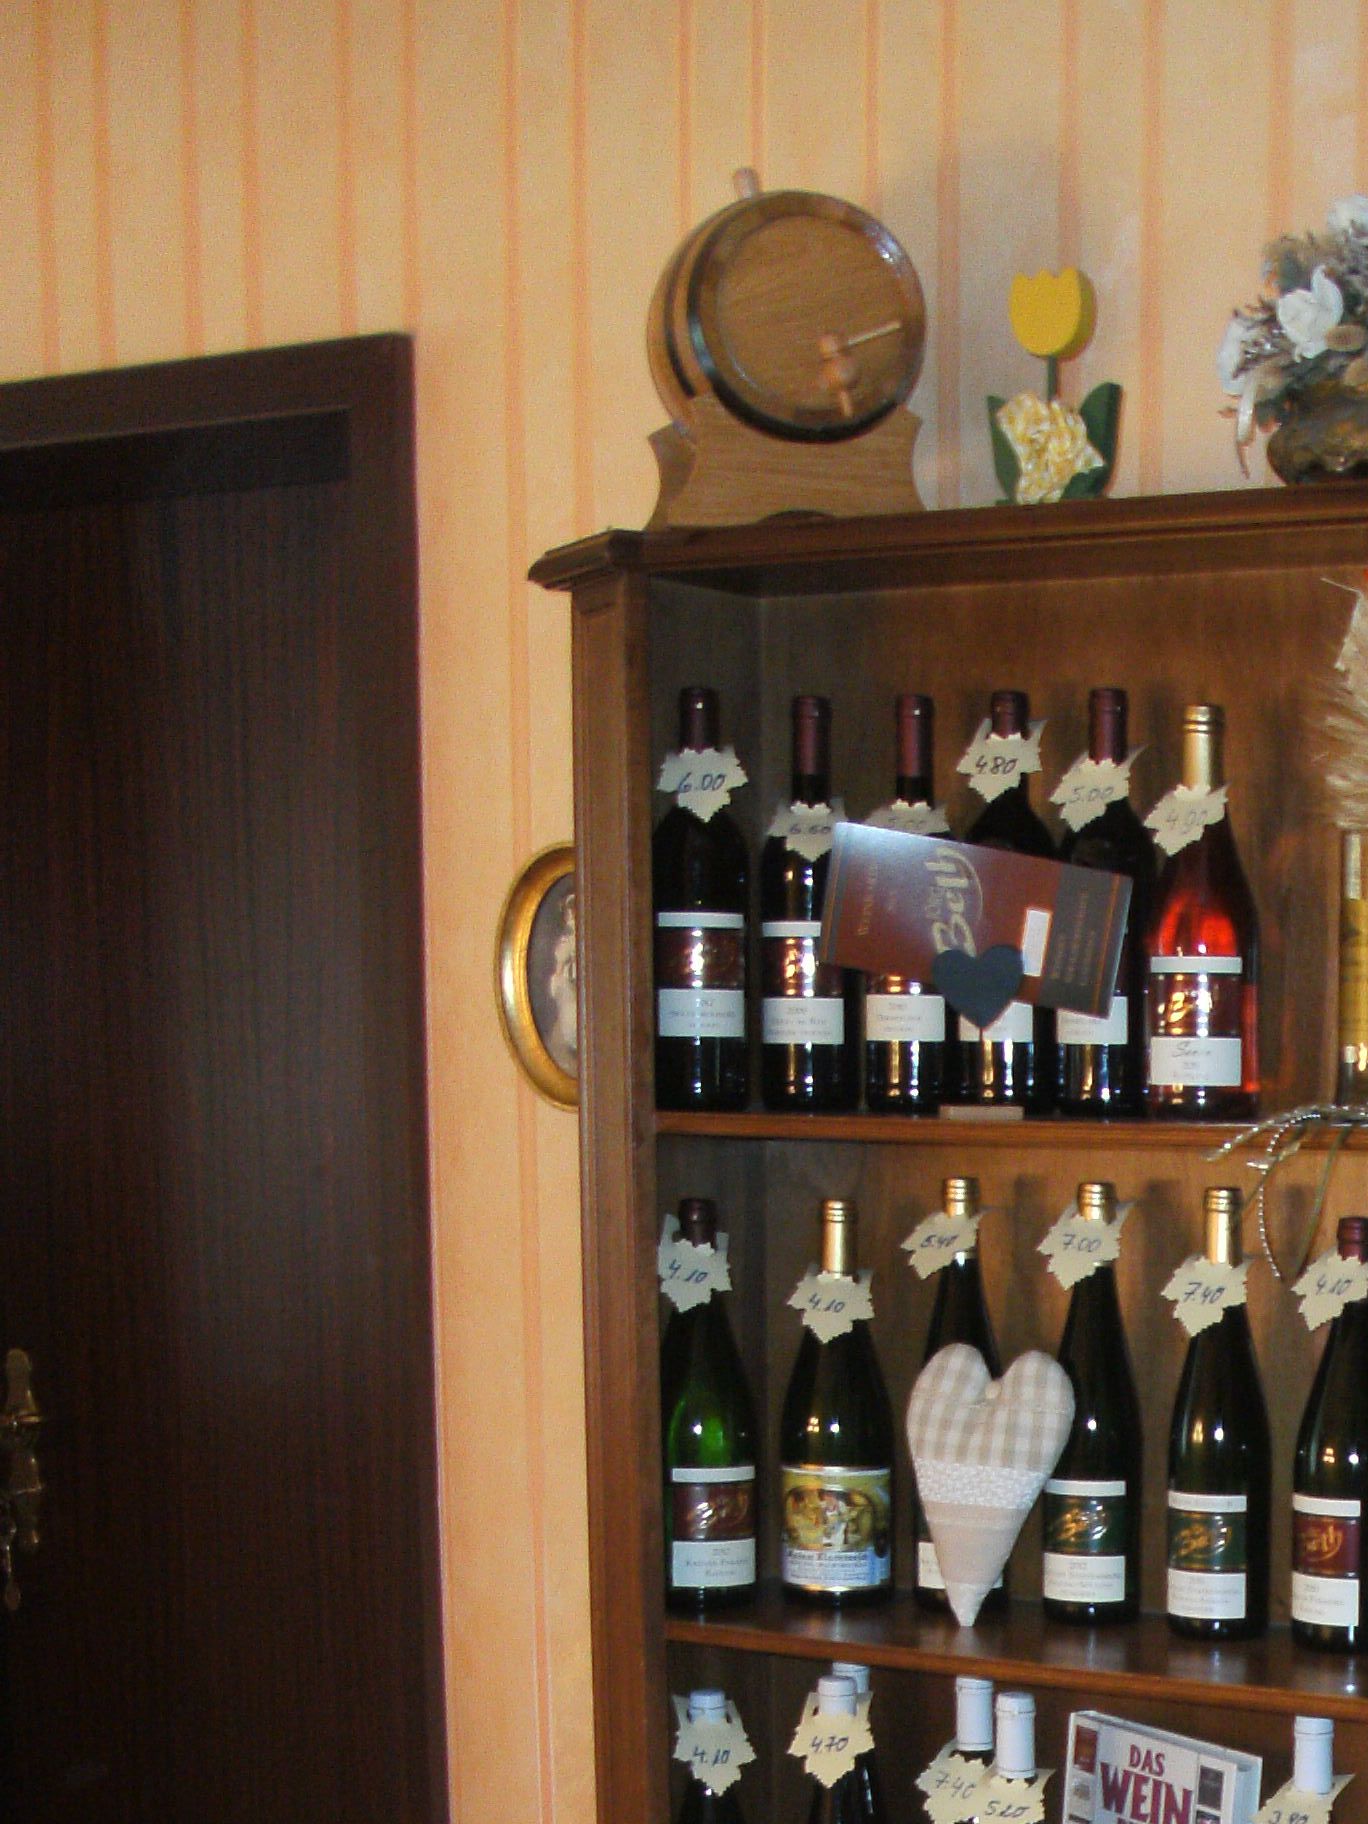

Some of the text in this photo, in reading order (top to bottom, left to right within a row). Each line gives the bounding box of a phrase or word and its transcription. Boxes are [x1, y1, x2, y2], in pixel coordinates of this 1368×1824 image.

[678, 771, 726, 793] 6.00
[1062, 1233, 1102, 1253] 7.00
[668, 1258, 709, 1284] 4.10
[808, 1292, 846, 1313] 4.10
[1183, 1281, 1226, 1305] 7.40
[693, 1746, 731, 1767] 4.10
[1129, 1744, 1165, 1777] DAS
